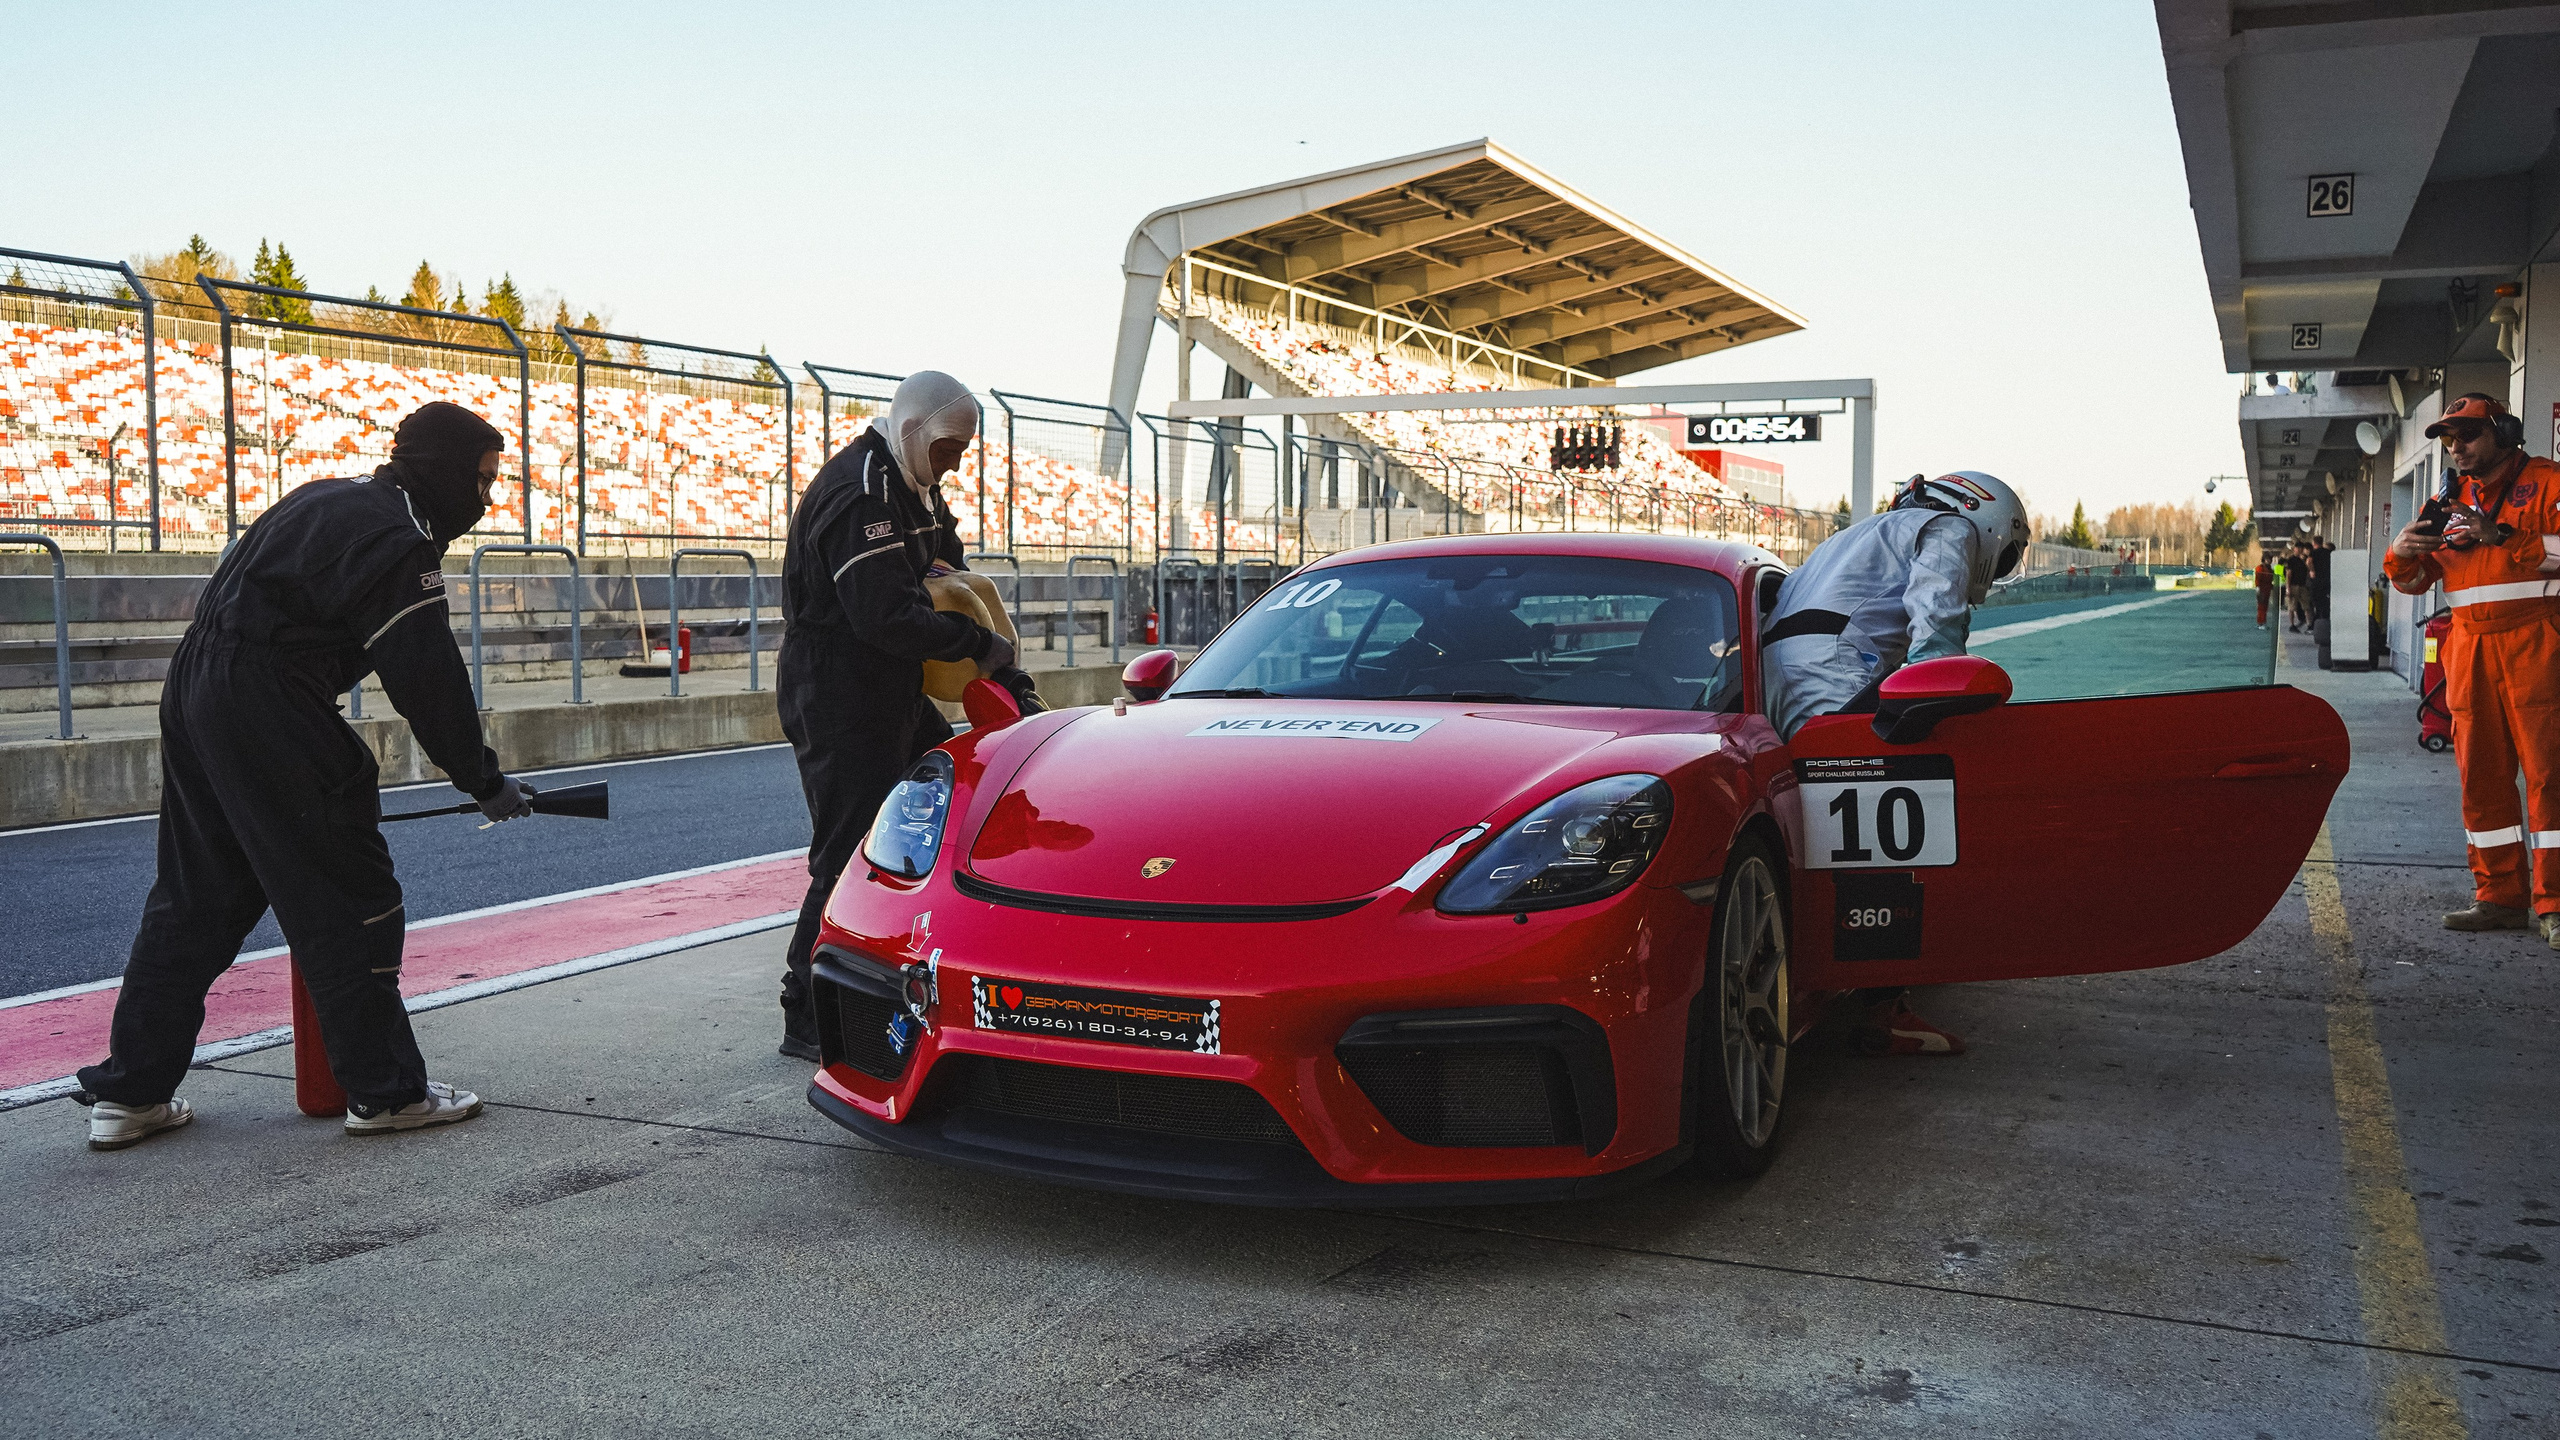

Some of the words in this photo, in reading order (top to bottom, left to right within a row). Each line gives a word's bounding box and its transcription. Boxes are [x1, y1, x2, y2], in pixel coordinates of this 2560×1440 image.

[2312, 179, 2350, 212] 26
[2294, 327, 2319, 347] 25
[2284, 431, 2298, 444] 24
[865, 523, 892, 538] OMP
[1265, 579, 1342, 612] 10
[1805, 758, 1884, 767] PORSCHE
[1825, 770, 1856, 778] CHALLENGE
[1829, 786, 1925, 862] 10
[1848, 907, 1891, 928] 360
[986, 984, 999, 1008] I
[1025, 996, 1203, 1024] GERMANMOTORSPORT
[998, 1013, 1188, 1043] +7(926)180-34-94
